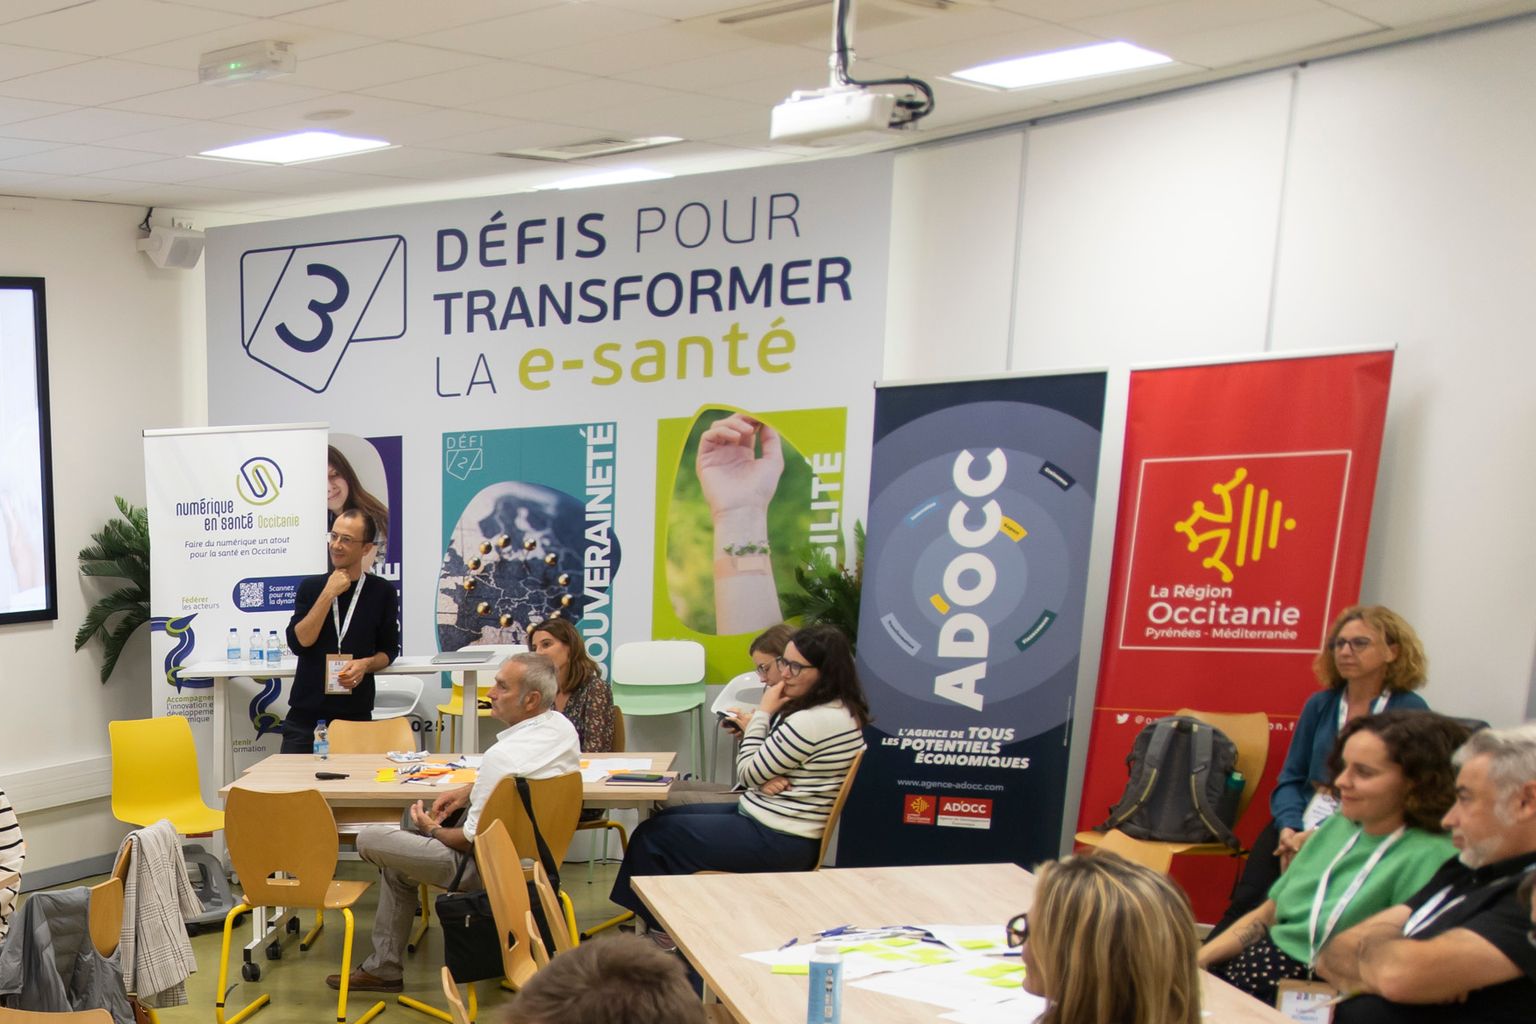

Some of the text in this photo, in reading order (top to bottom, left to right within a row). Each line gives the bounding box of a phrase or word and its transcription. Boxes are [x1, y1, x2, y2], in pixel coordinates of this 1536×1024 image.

[437, 193, 800, 272] DÉFIS POUR
[433, 256, 852, 335] TRANSFORMER
[275, 263, 350, 352] 3
[436, 317, 797, 398] LA e-santé
[446, 433, 483, 449] DÉFI
[176, 498, 234, 517] numérique
[204, 512, 300, 531] en santé Occitanie
[184, 540, 203, 548] Faire
[205, 539, 215, 547] du
[216, 537, 257, 549] numérique
[269, 537, 290, 545] atout
[190, 551, 208, 560] pour
[209, 550, 217, 558] la
[218, 548, 239, 557] santé
[251, 547, 287, 556] Occitanie
[182, 596, 208, 604] Fédérer
[268, 592, 283, 600] pour
[1150, 584, 1232, 601] La Région
[182, 602, 220, 611] les acteurs
[1147, 600, 1300, 625] Occitanie
[1145, 627, 1201, 640] Pyrénées
[1212, 628, 1298, 640] Méditerranée
[167, 695, 214, 703] Accompagner
[411, 720, 445, 732] 025
[898, 726, 1015, 741] L'AGENCE DE TOUS
[881, 738, 1002, 754] LES POTENTIELS
[915, 750, 1030, 769] ÉCONOMIQUES
[897, 778, 1004, 792] www.agence-adocc.com
